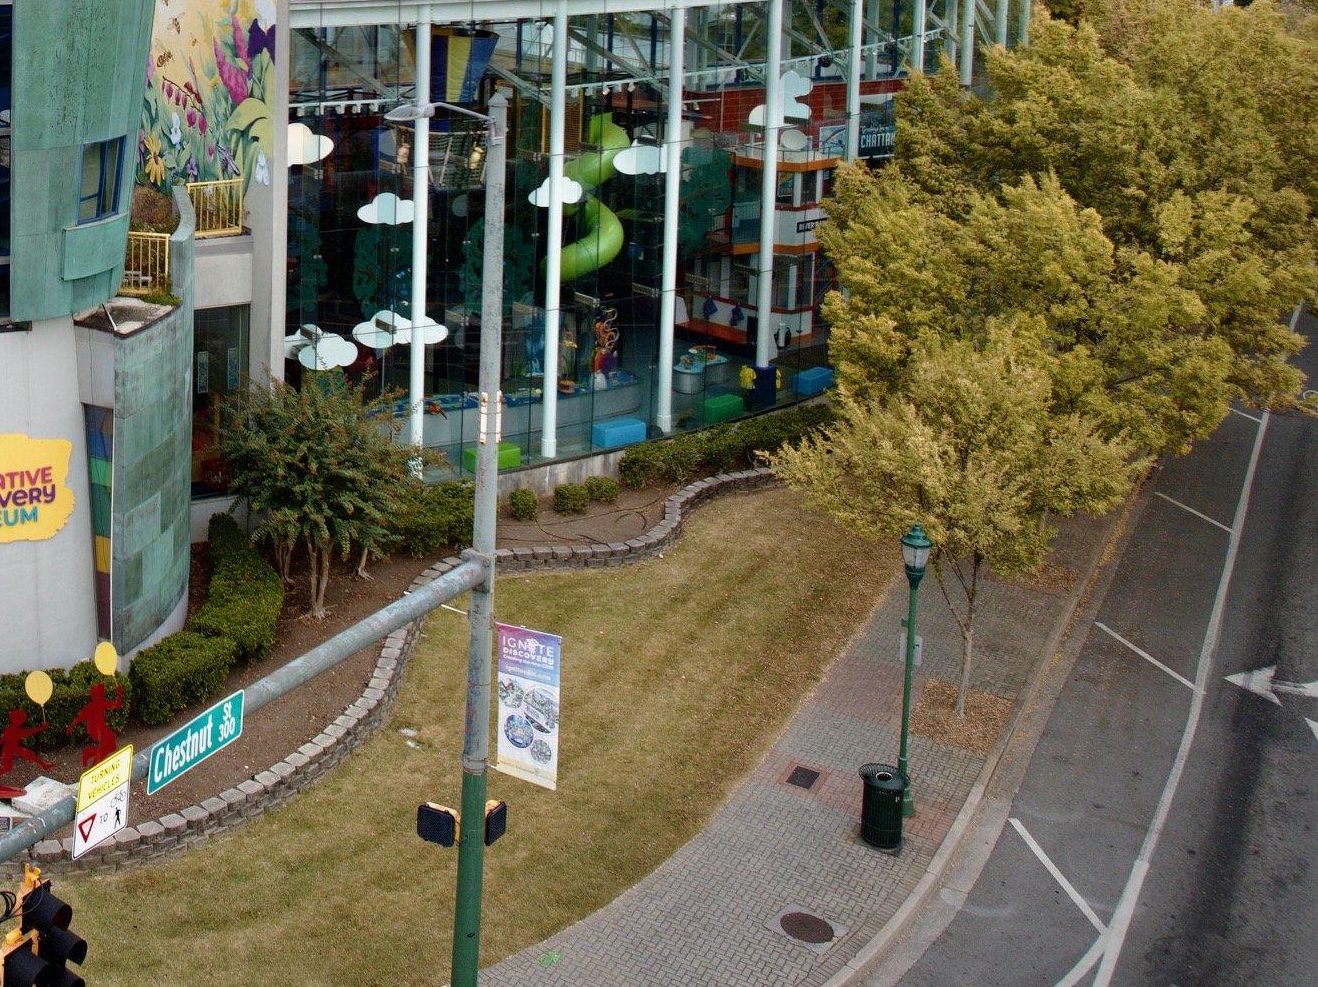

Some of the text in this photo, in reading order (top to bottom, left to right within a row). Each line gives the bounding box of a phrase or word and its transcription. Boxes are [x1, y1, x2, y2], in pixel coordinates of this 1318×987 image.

[503, 647, 555, 665] DISCOVERY
[218, 716, 236, 742] 300
[154, 701, 232, 783] Chestnut St
[90, 760, 120, 784] TURNING
[88, 774, 120, 800] VEHICLES
[100, 813, 109, 824] TO
